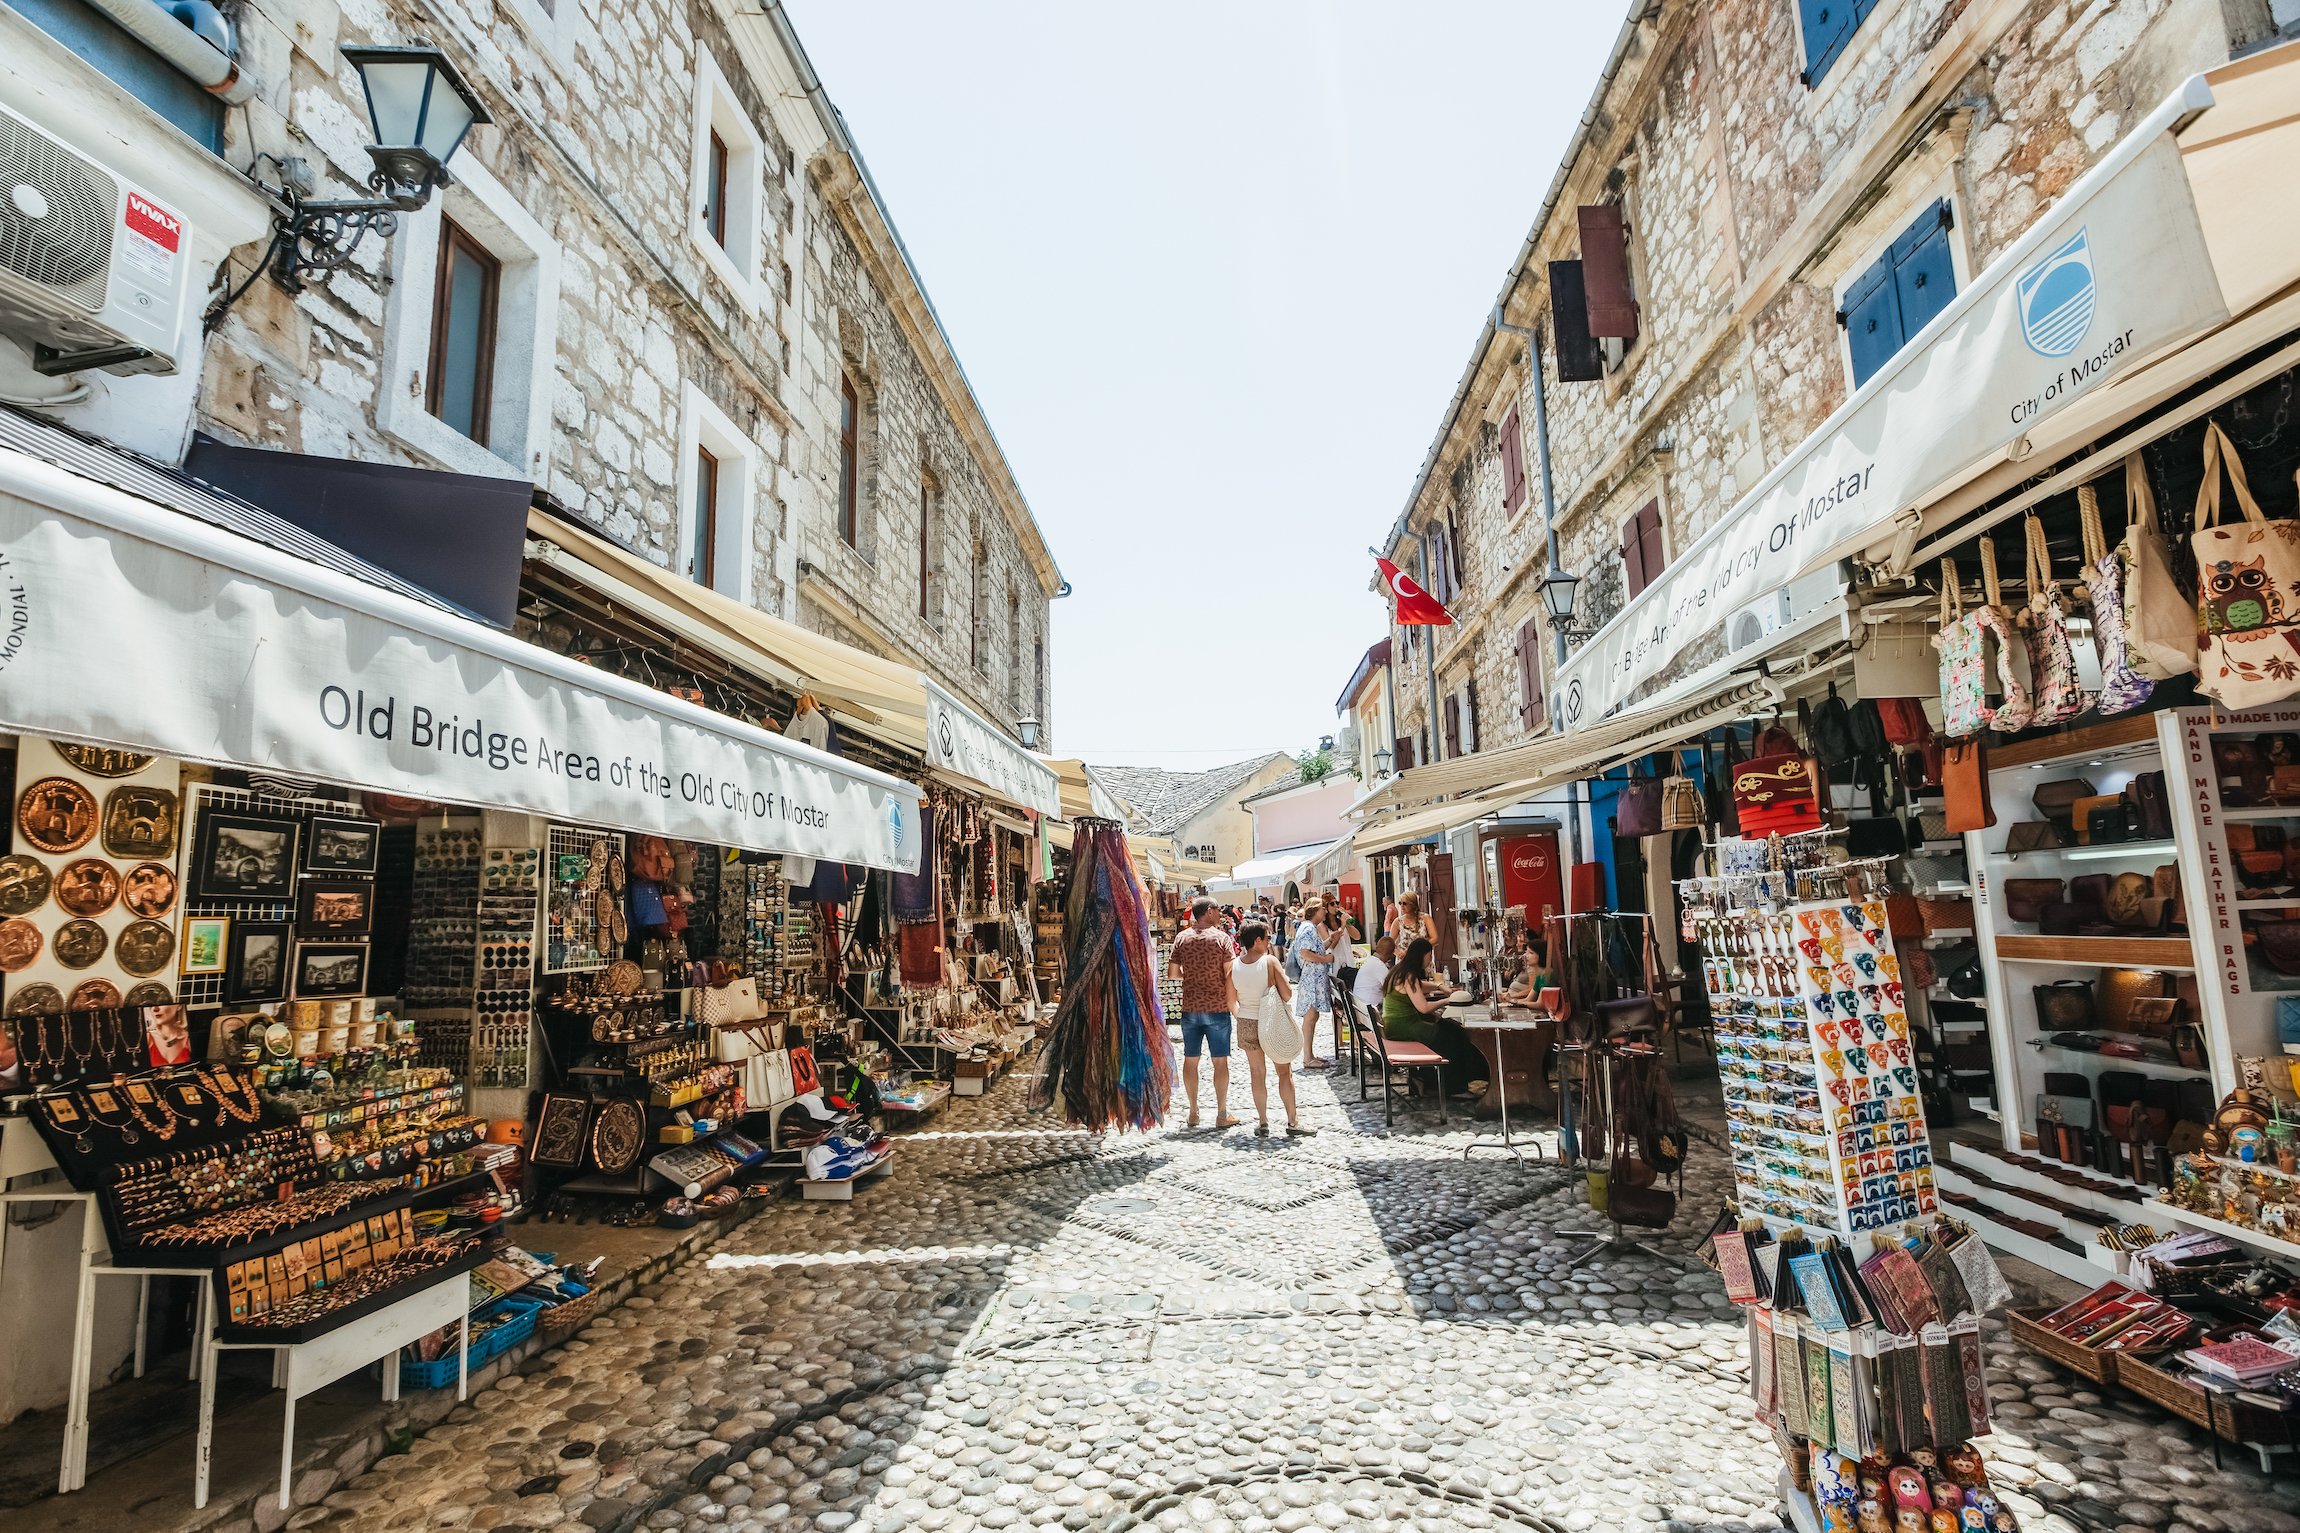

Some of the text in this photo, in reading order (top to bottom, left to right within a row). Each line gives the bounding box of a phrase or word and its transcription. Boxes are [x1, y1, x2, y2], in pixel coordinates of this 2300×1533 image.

[129, 195, 180, 237] VIVAX
[2011, 329, 2133, 424] City of Mostar
[1672, 598, 1686, 628] of
[1736, 540, 1763, 578] City
[1769, 513, 1798, 553] Of
[0, 585, 29, 663] MONDIAL
[319, 685, 829, 830] Old Bridge Area of the Old City Of Mostar
[2186, 715, 2226, 726] HAD
[2230, 713, 2272, 724] MADE
[2195, 778, 2213, 826] MADE
[2208, 842, 2229, 929] LEATHER
[2223, 945, 2240, 994] BAGS
[1926, 1334, 1948, 1342] BOOKMARK
